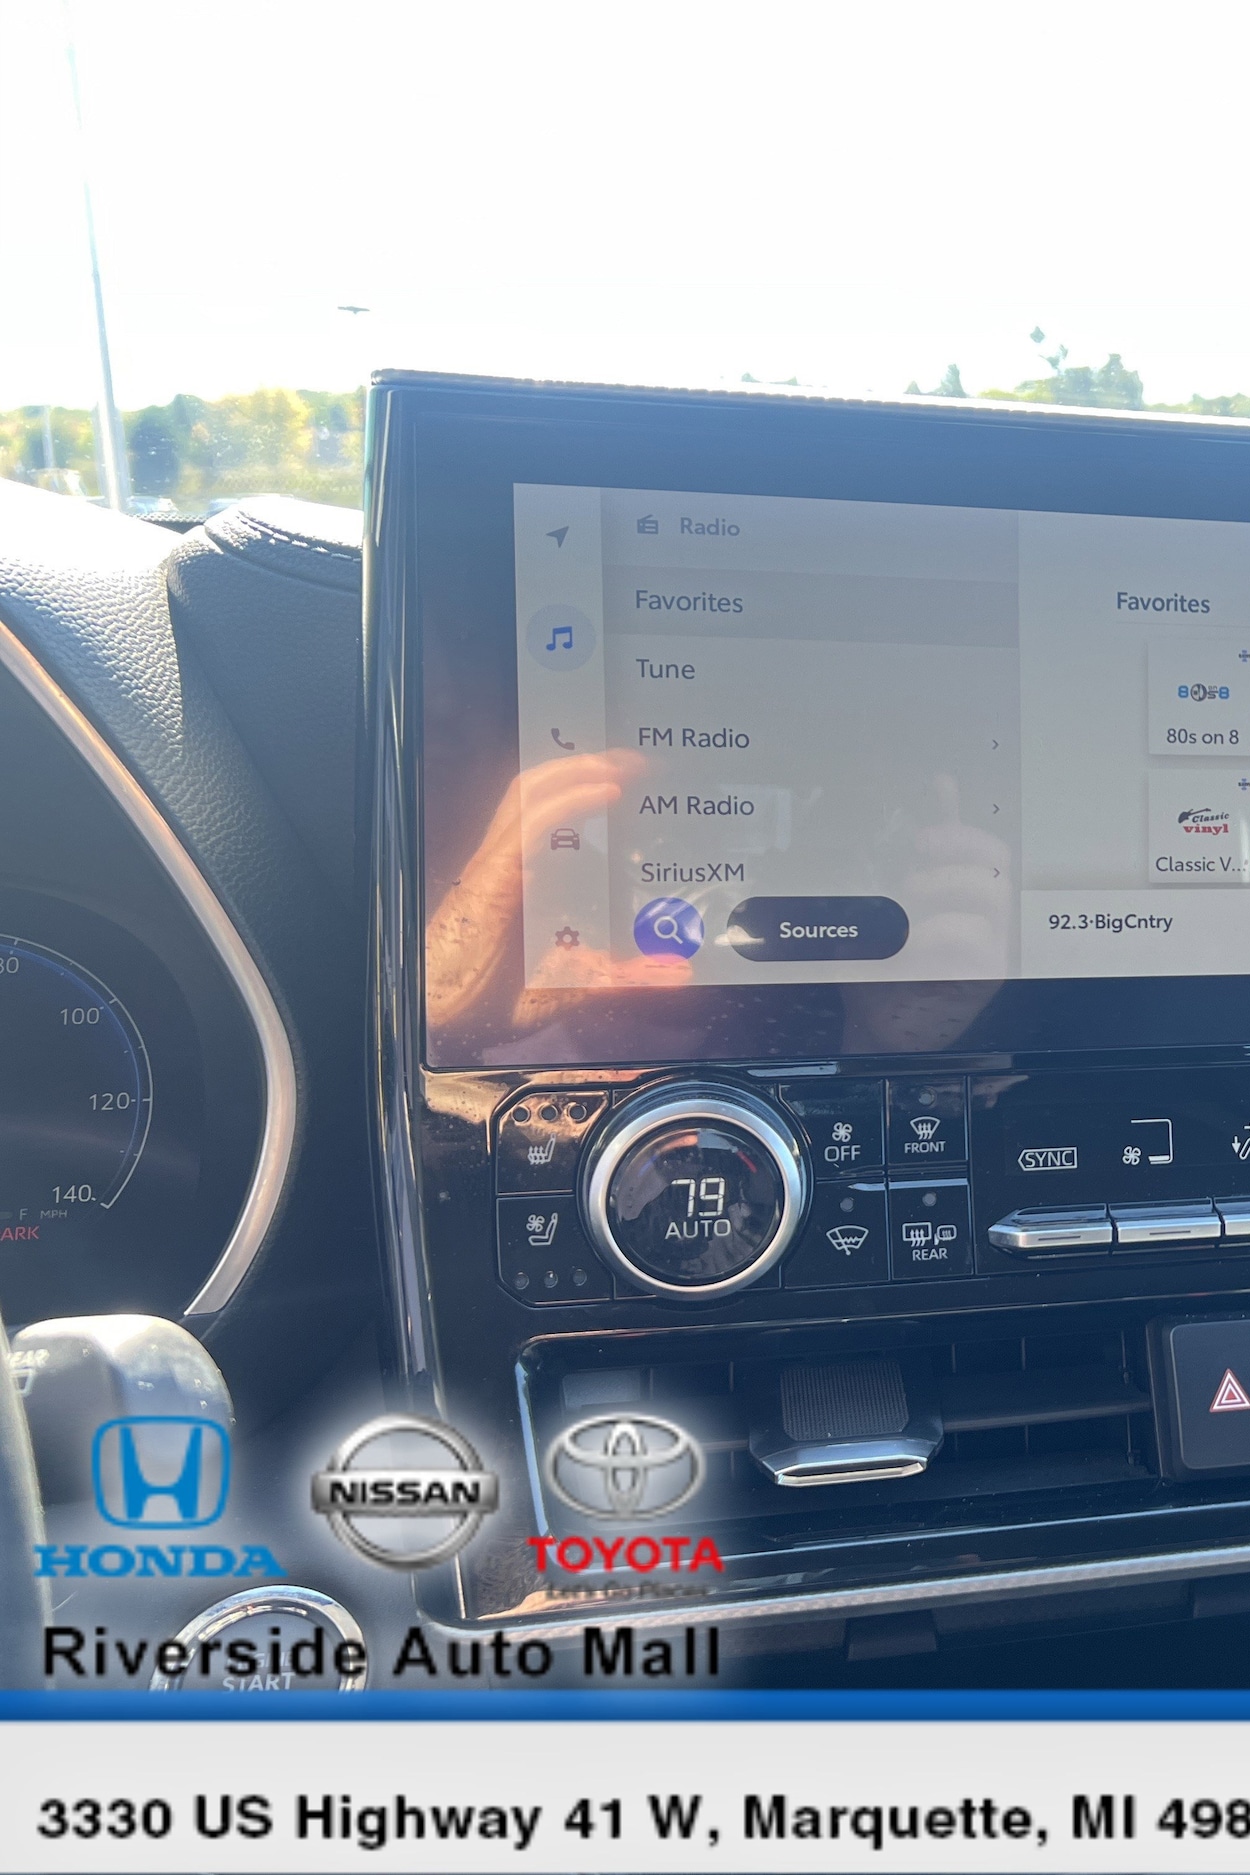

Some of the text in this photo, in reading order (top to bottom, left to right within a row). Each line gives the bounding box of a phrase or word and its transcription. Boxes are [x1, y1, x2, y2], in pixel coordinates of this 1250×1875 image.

[680, 517, 741, 537] Radio
[635, 590, 744, 614] Favorites
[1116, 592, 1211, 615] Favorites
[636, 658, 696, 680] Tune
[638, 727, 751, 750] FM Radio
[1166, 728, 1240, 745] 80s on 8
[639, 796, 755, 817] AM Radio
[1192, 812, 1230, 824] Classic
[1183, 824, 1230, 836] vinyl
[640, 862, 746, 883] SiriusXM
[1155, 857, 1215, 872] Classic
[779, 922, 859, 940] Sources
[59, 1007, 101, 1026] 100
[88, 1092, 131, 1111] 120
[824, 1144, 861, 1162] OFF
[904, 1140, 946, 1155] FRONT
[1025, 1150, 1075, 1169] SYNC
[51, 1184, 93, 1204] 140
[669, 1176, 727, 1218] 79
[19, 1208, 28, 1221] F
[40, 1208, 69, 1220] MPH
[0, 1225, 41, 1242] ARK
[665, 1219, 732, 1241] AUTO
[911, 1246, 949, 1261] REAR
